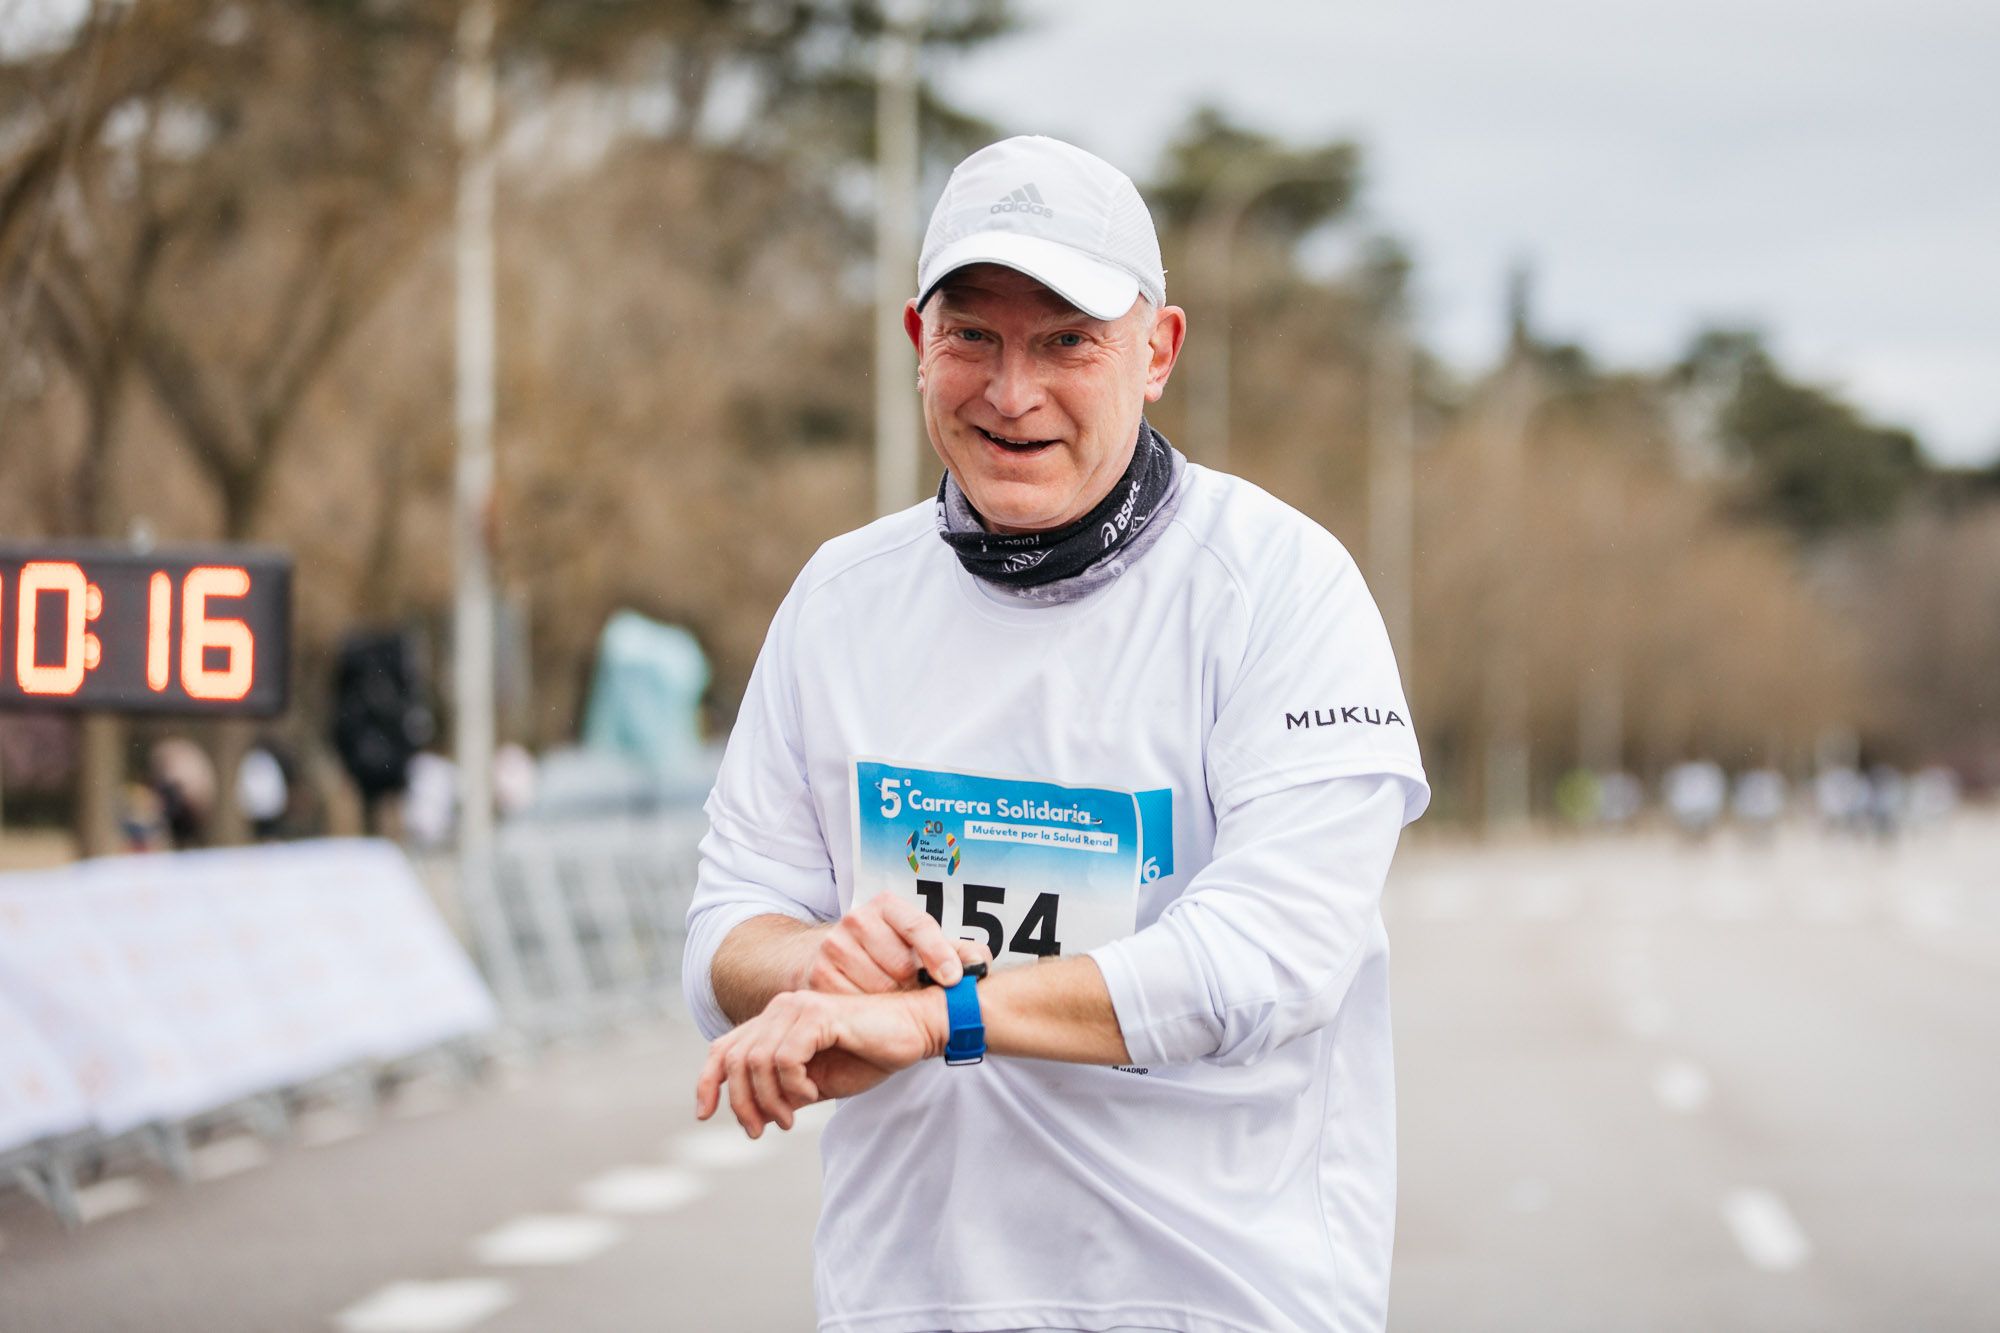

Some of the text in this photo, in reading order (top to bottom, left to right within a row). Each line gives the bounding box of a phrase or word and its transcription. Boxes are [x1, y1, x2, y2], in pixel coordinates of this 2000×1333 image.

[990, 199, 1054, 219] adidas
[1286, 706, 1406, 730] MUKUA
[908, 789, 991, 816] Carrera
[997, 797, 1091, 825] Solidaria
[972, 825, 1113, 847] Muévete por la Salud Renal
[916, 879, 1062, 960] 154
